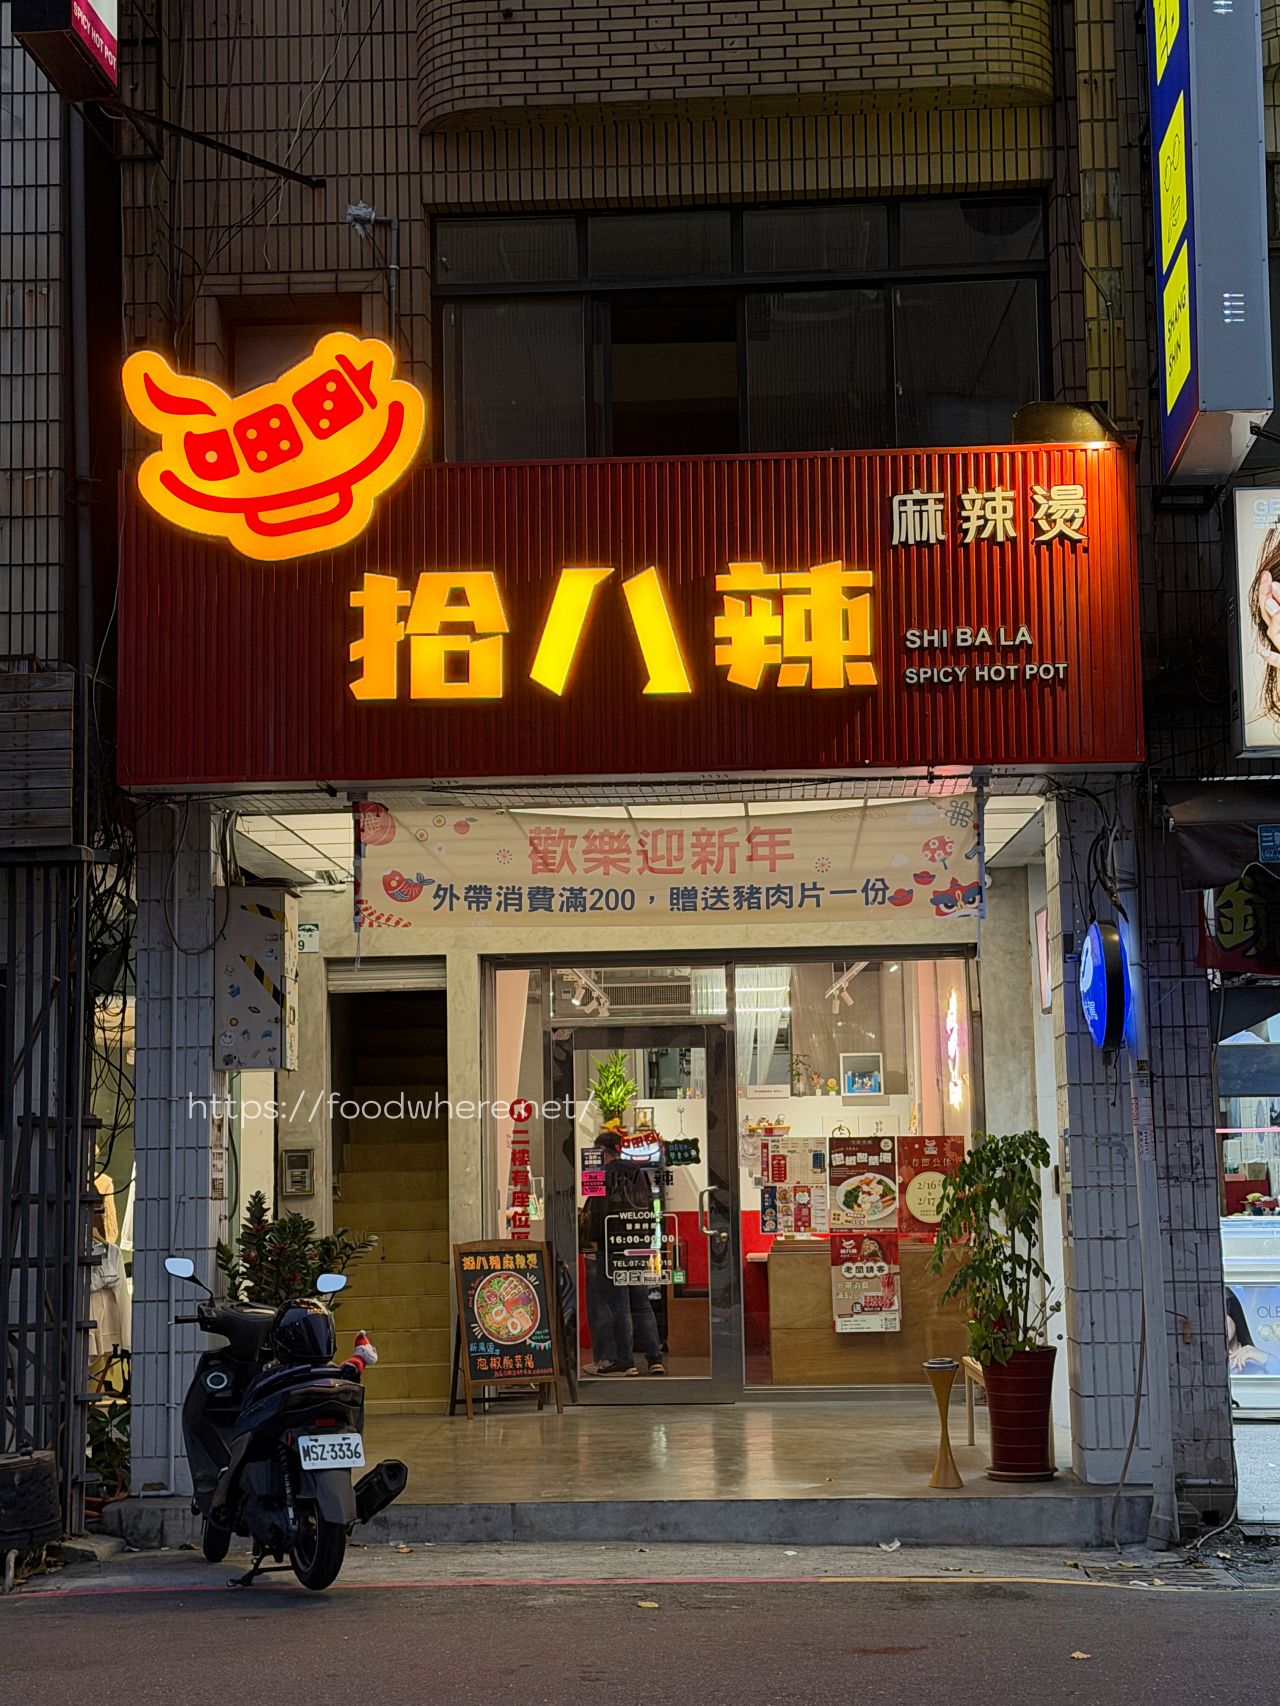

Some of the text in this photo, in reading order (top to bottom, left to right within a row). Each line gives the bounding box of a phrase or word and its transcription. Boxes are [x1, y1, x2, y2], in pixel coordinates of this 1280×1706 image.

[73, 1, 117, 71] SPICY HOT POT
[892, 484, 1088, 546] 麻辣燙
[349, 560, 878, 700] 拾八辣
[905, 624, 1033, 649] SHI BA LA
[905, 663, 1068, 684] SPICY HOT POT
[528, 825, 795, 876] 歡樂迎新年
